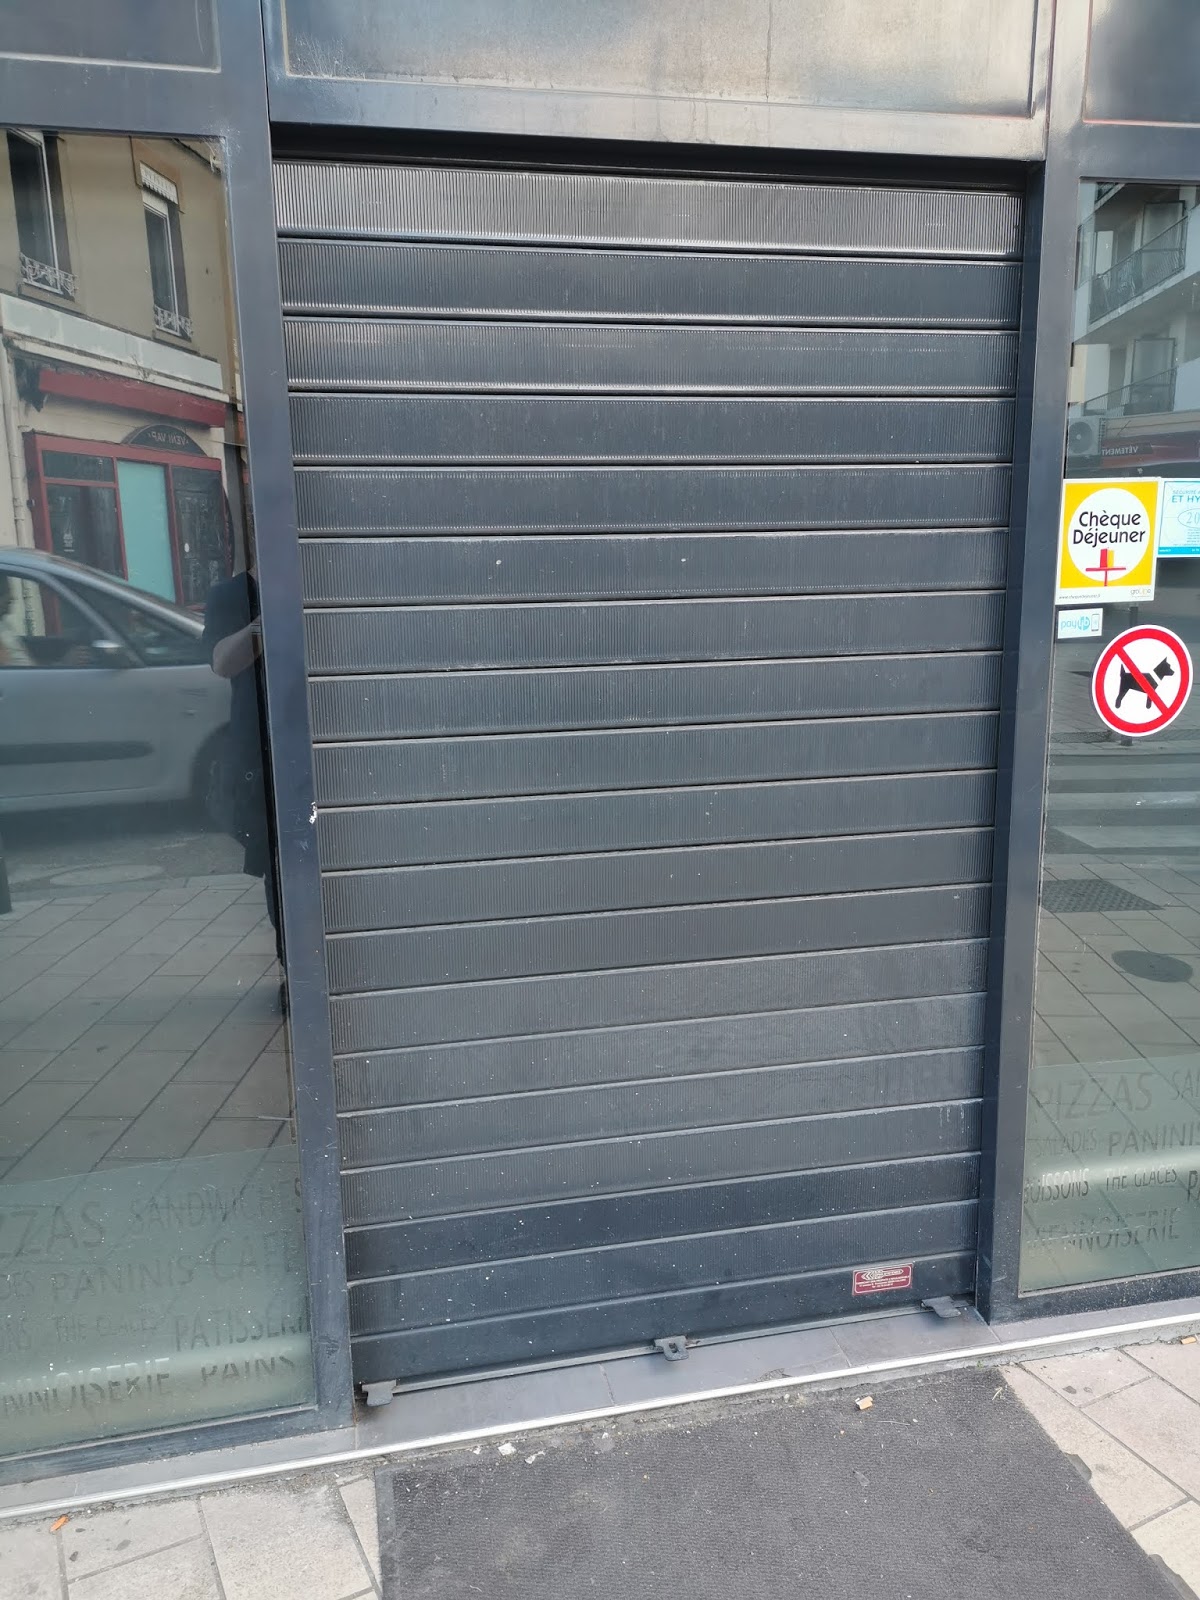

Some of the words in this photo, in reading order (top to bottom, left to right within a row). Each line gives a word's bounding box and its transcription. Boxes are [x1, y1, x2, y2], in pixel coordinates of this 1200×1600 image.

[1171, 495, 1184, 503] ET
[1079, 510, 1141, 529] Chèque
[1073, 528, 1146, 548] Déjeuner
[51, 1254, 194, 1302] PANINIS
